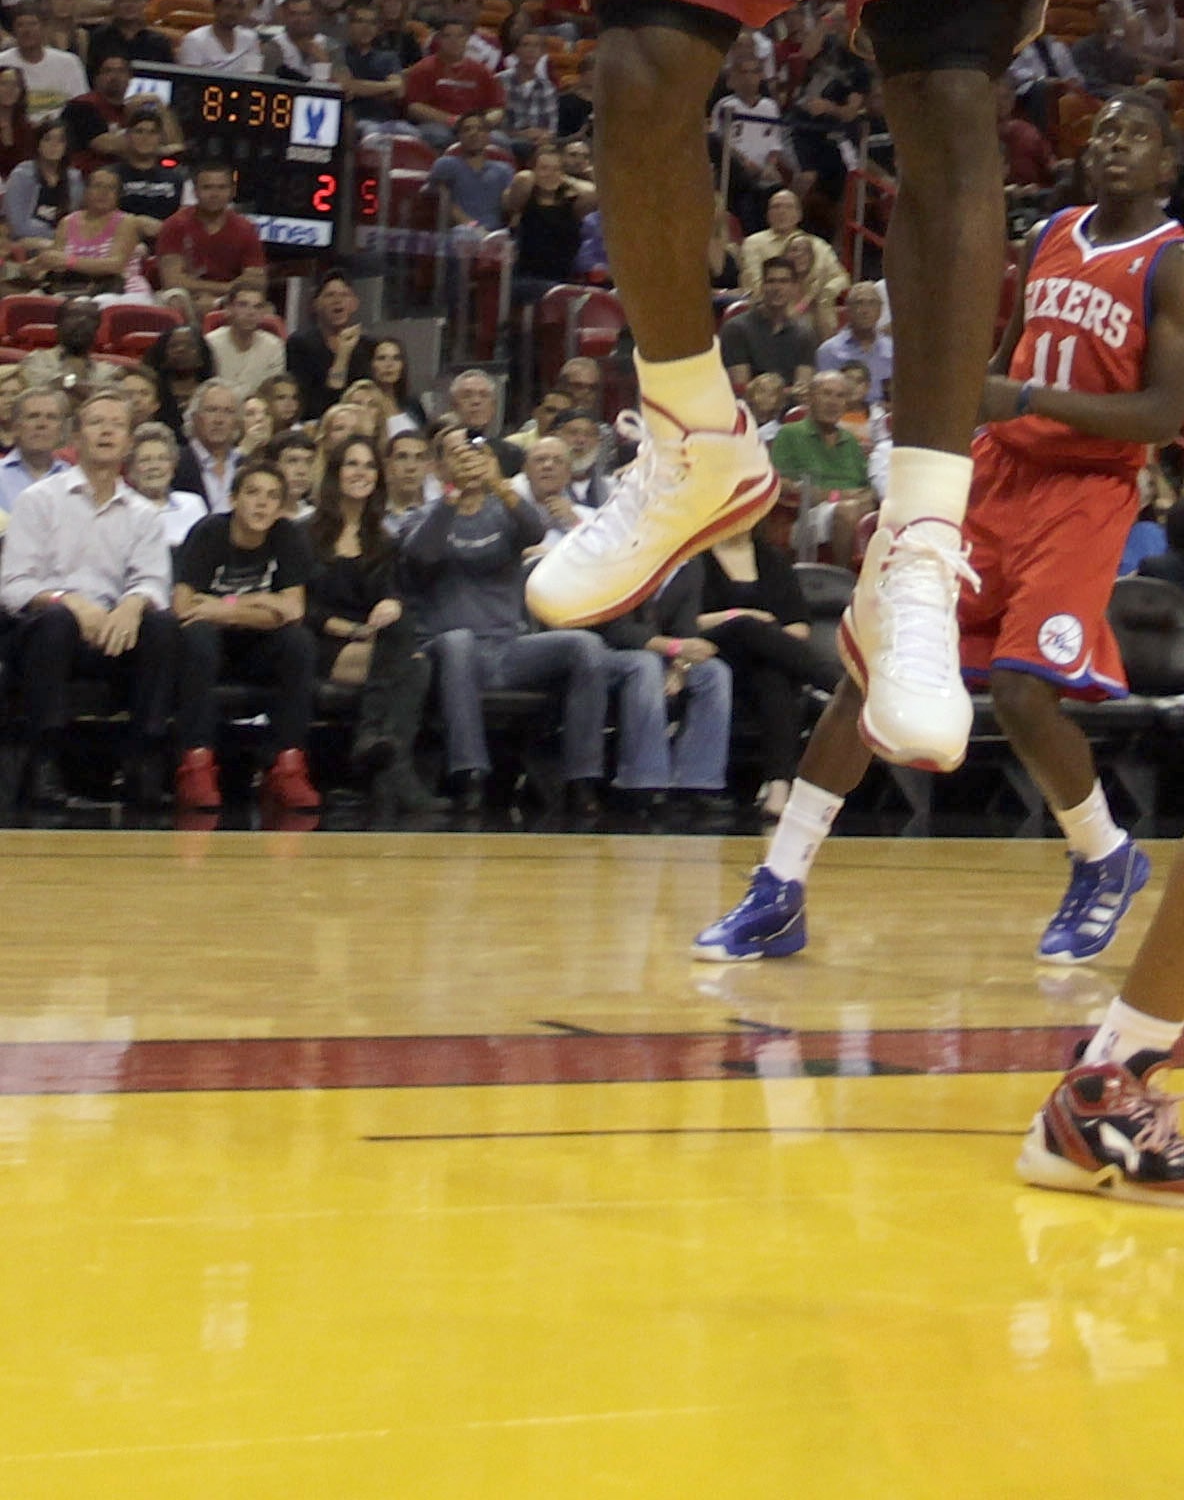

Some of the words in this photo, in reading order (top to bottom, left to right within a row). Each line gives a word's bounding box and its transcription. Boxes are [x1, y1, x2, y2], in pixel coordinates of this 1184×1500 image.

[203, 86, 292, 129] 8:38
[312, 174, 336, 212] 2
[1023, 331, 1078, 392] 11
